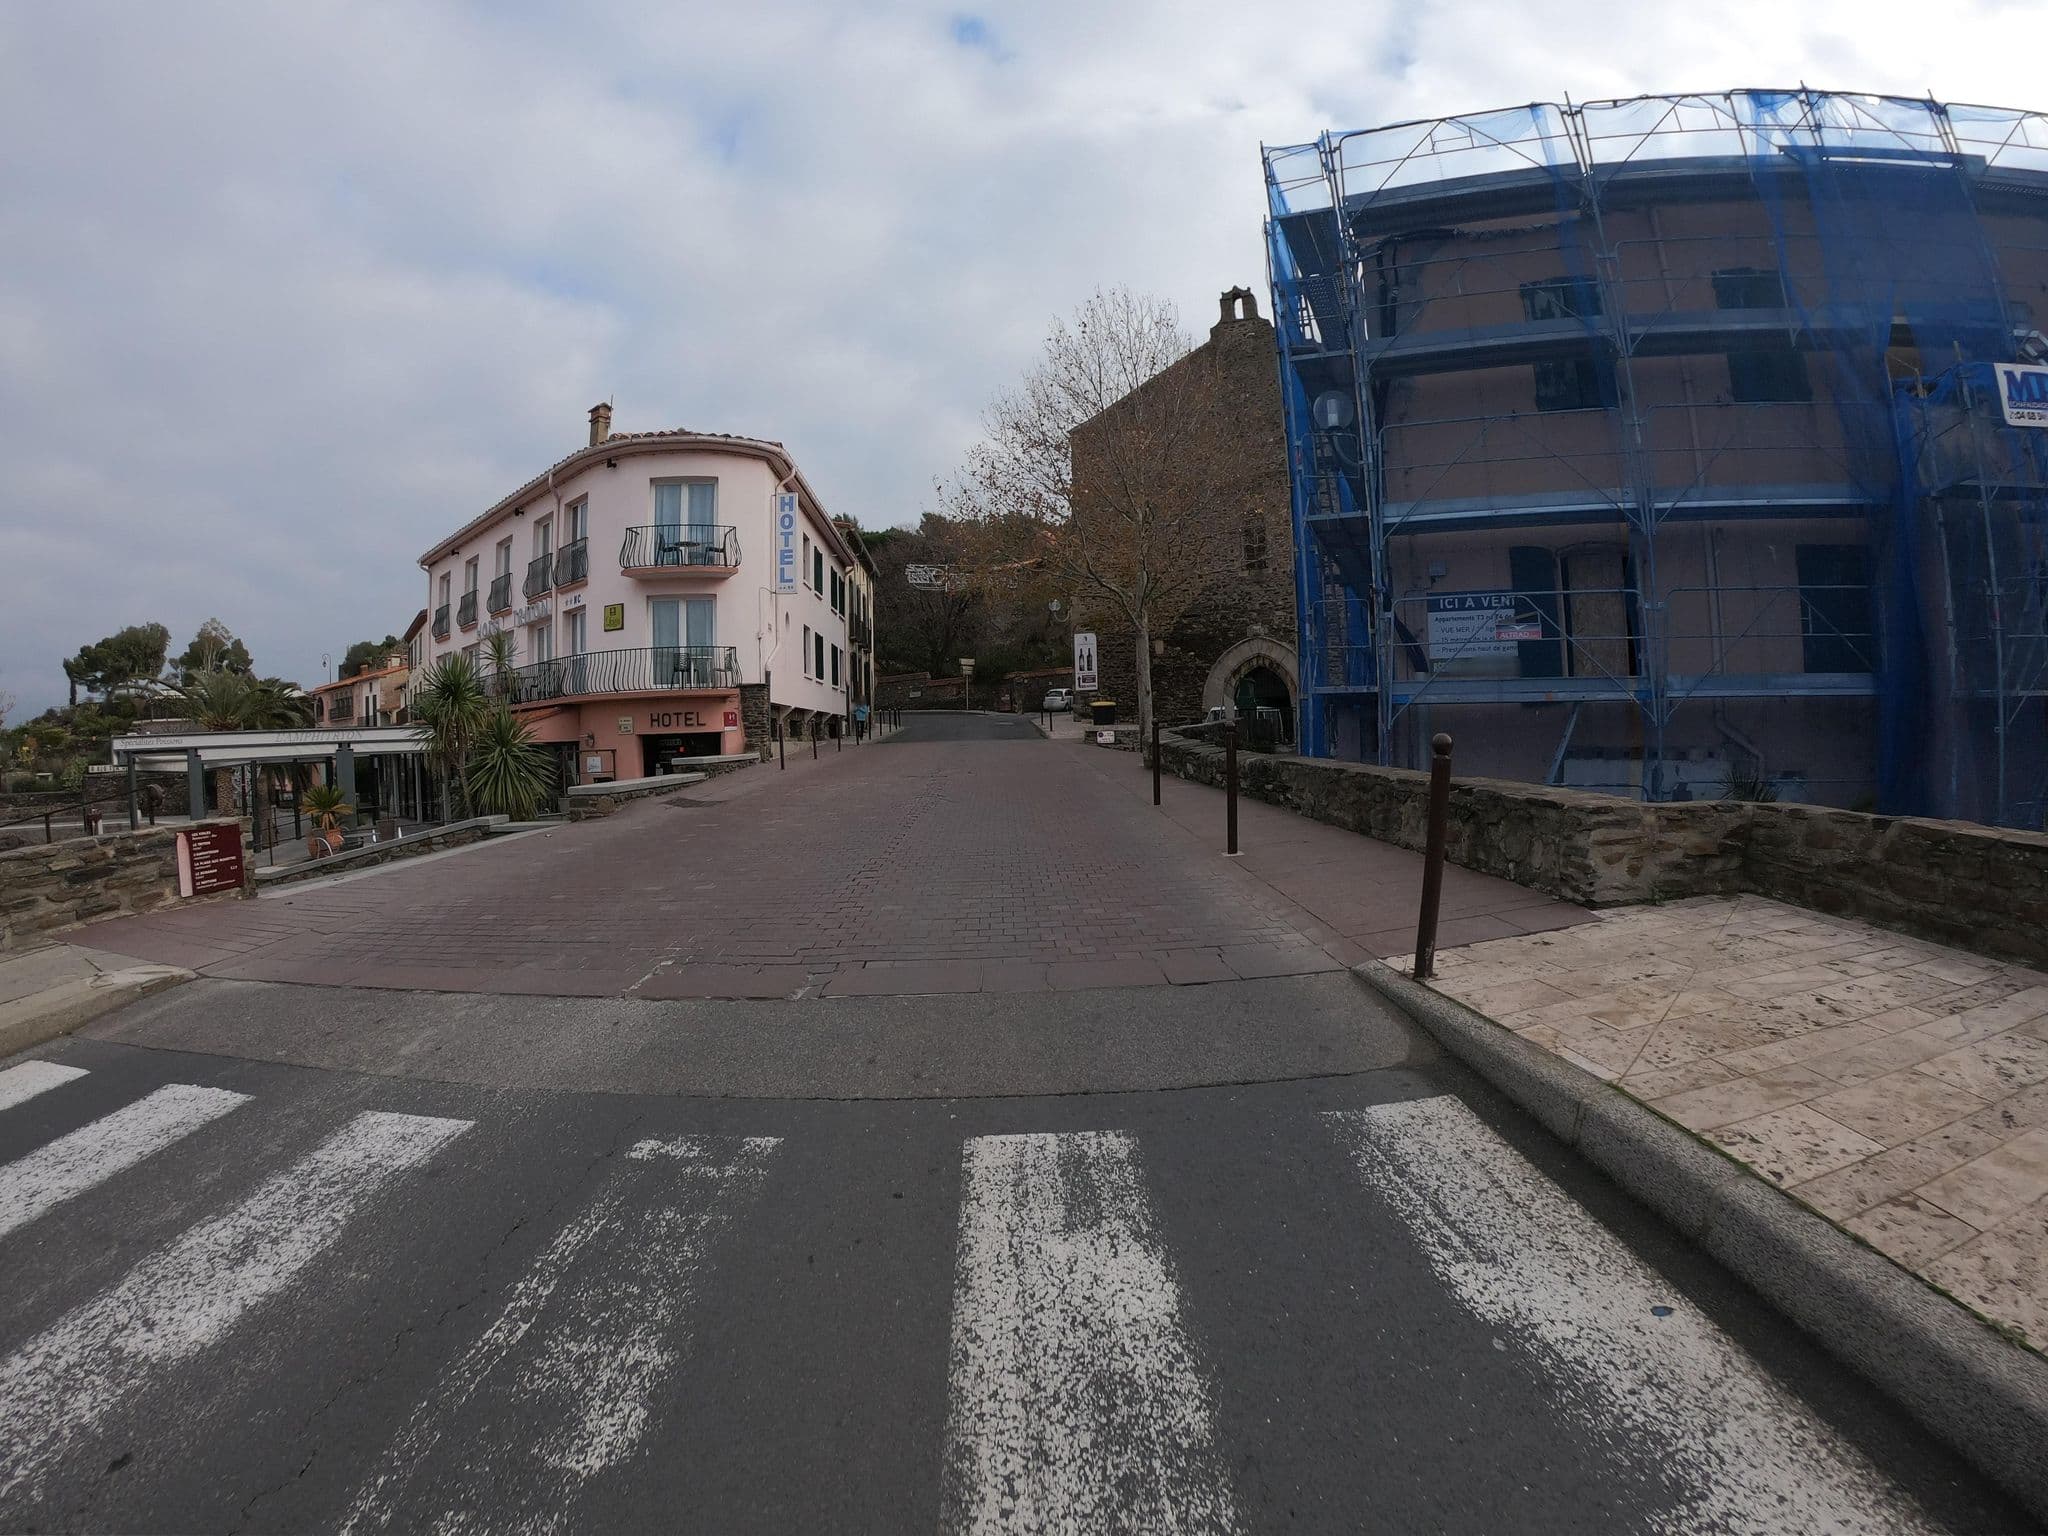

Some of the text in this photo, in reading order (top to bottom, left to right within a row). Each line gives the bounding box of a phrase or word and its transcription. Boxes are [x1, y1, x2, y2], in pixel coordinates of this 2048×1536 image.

[780, 495, 794, 584] HOTEL
[1440, 598, 1459, 609] ICI
[1500, 631, 1530, 639] ALTRAD
[650, 711, 707, 728] HOTEL
